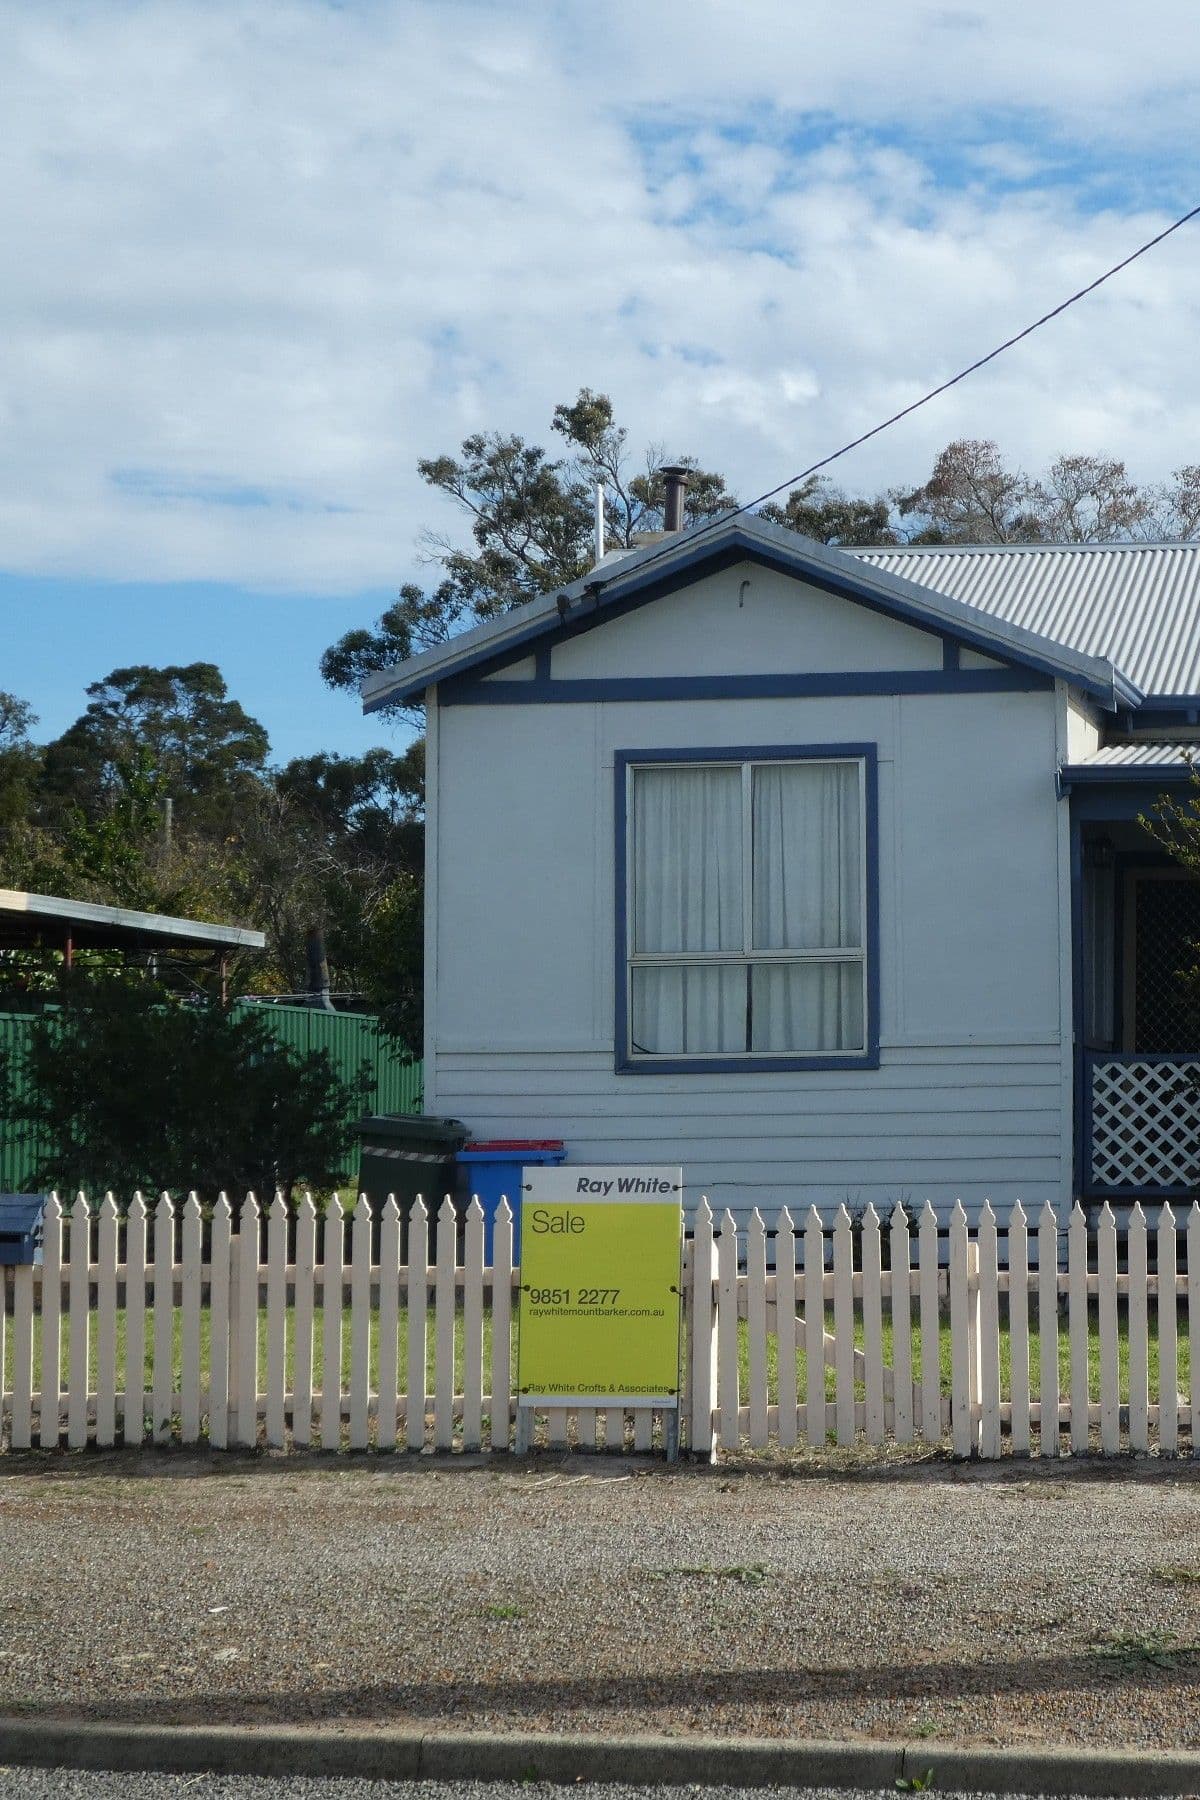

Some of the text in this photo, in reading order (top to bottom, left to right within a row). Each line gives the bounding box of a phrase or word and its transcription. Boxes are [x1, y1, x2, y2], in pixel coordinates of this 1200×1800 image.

[576, 1177, 671, 1196] Ray White
[531, 1210, 585, 1234] Sale
[530, 1289, 620, 1305] 9851 2277
[529, 1307, 665, 1317] raywhitemountbarker.com.au
[528, 1383, 669, 1394] Ray White Crofts & Associates
